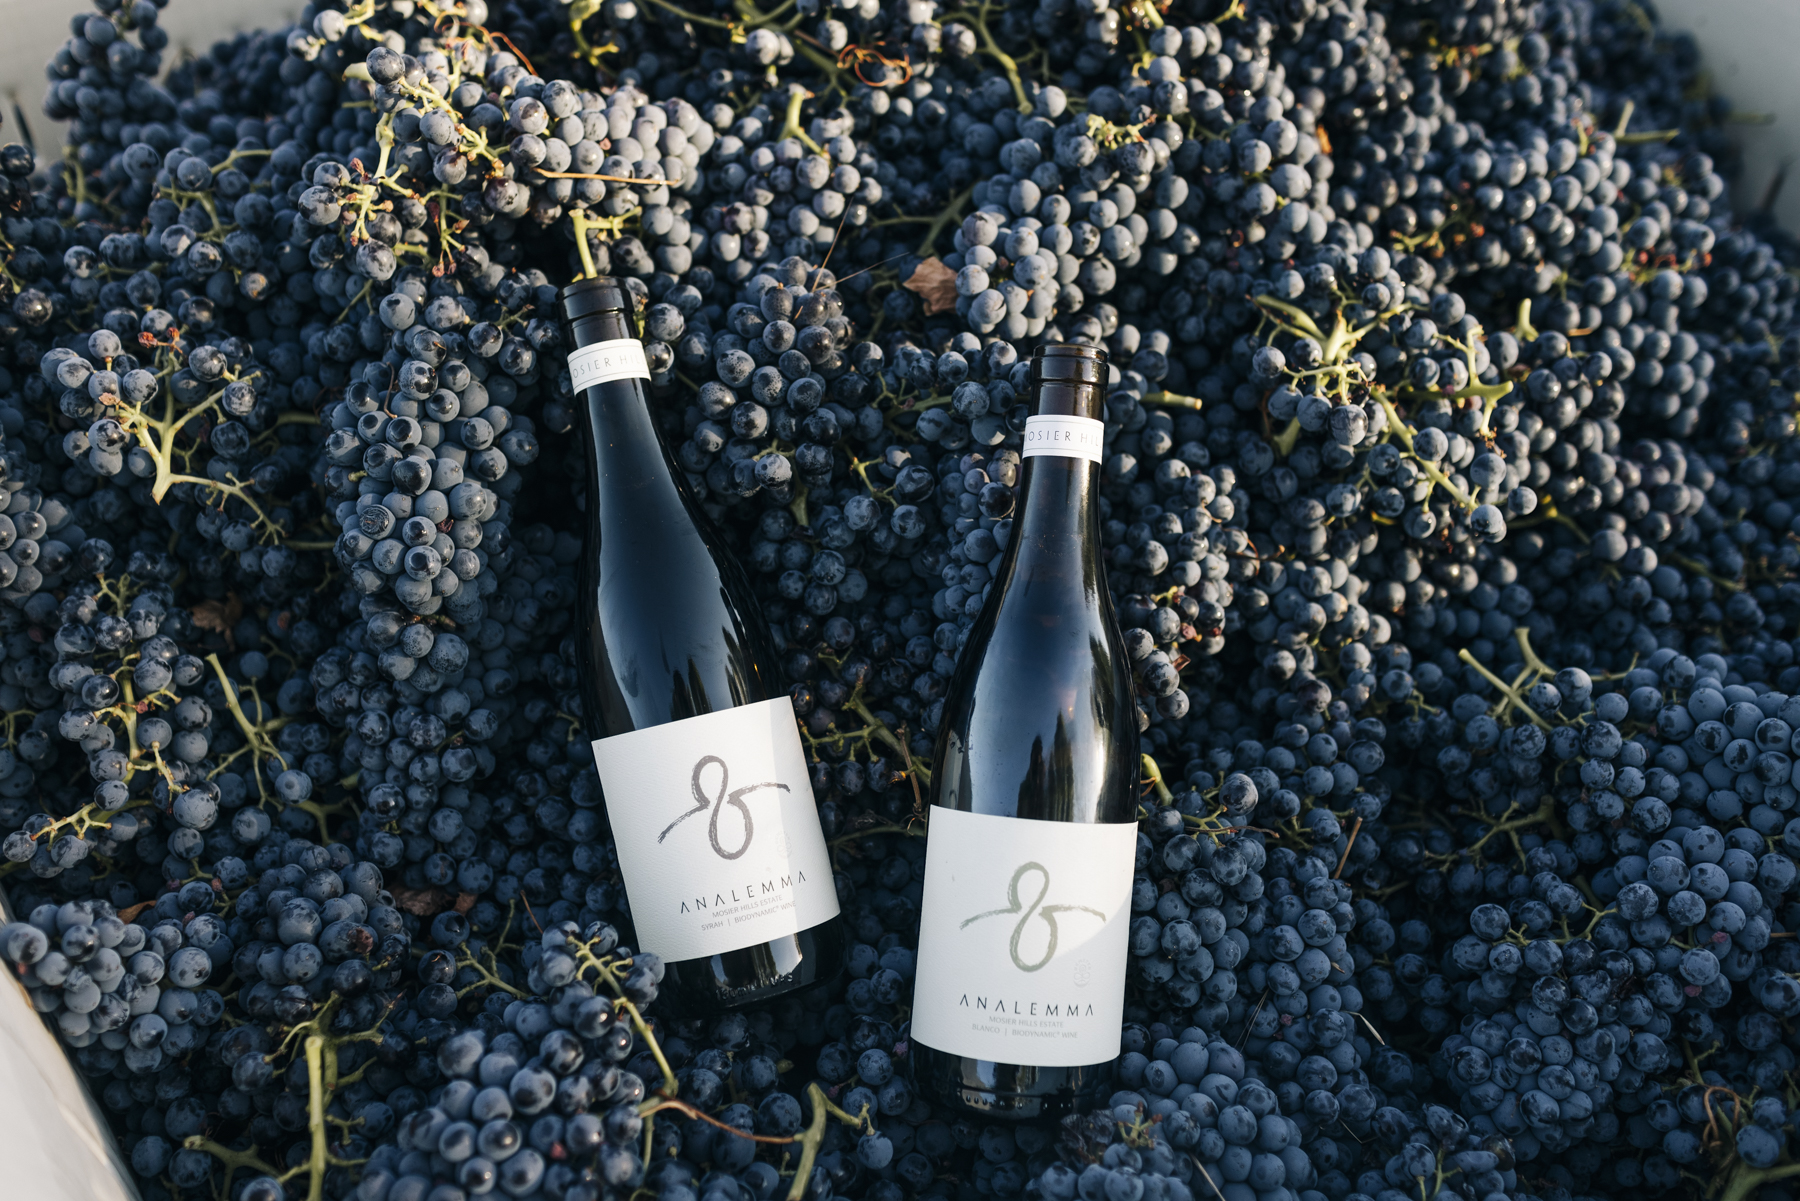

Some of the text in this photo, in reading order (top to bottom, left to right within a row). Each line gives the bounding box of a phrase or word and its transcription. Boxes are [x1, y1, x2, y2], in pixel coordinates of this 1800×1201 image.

[1025, 430, 1071, 443] OSIER
[680, 870, 806, 914] ANALEMMA
[701, 920, 724, 931] SYRAH
[780, 900, 797, 911] WINE
[712, 894, 783, 919] MOSIER HILLS ESTATE
[959, 993, 1094, 1017] ANALEMMA
[971, 1023, 1001, 1034] BLANCO
[1061, 1031, 1078, 1039] WINE
[988, 1015, 1064, 1029] MOSIER HILLS ESTATE
